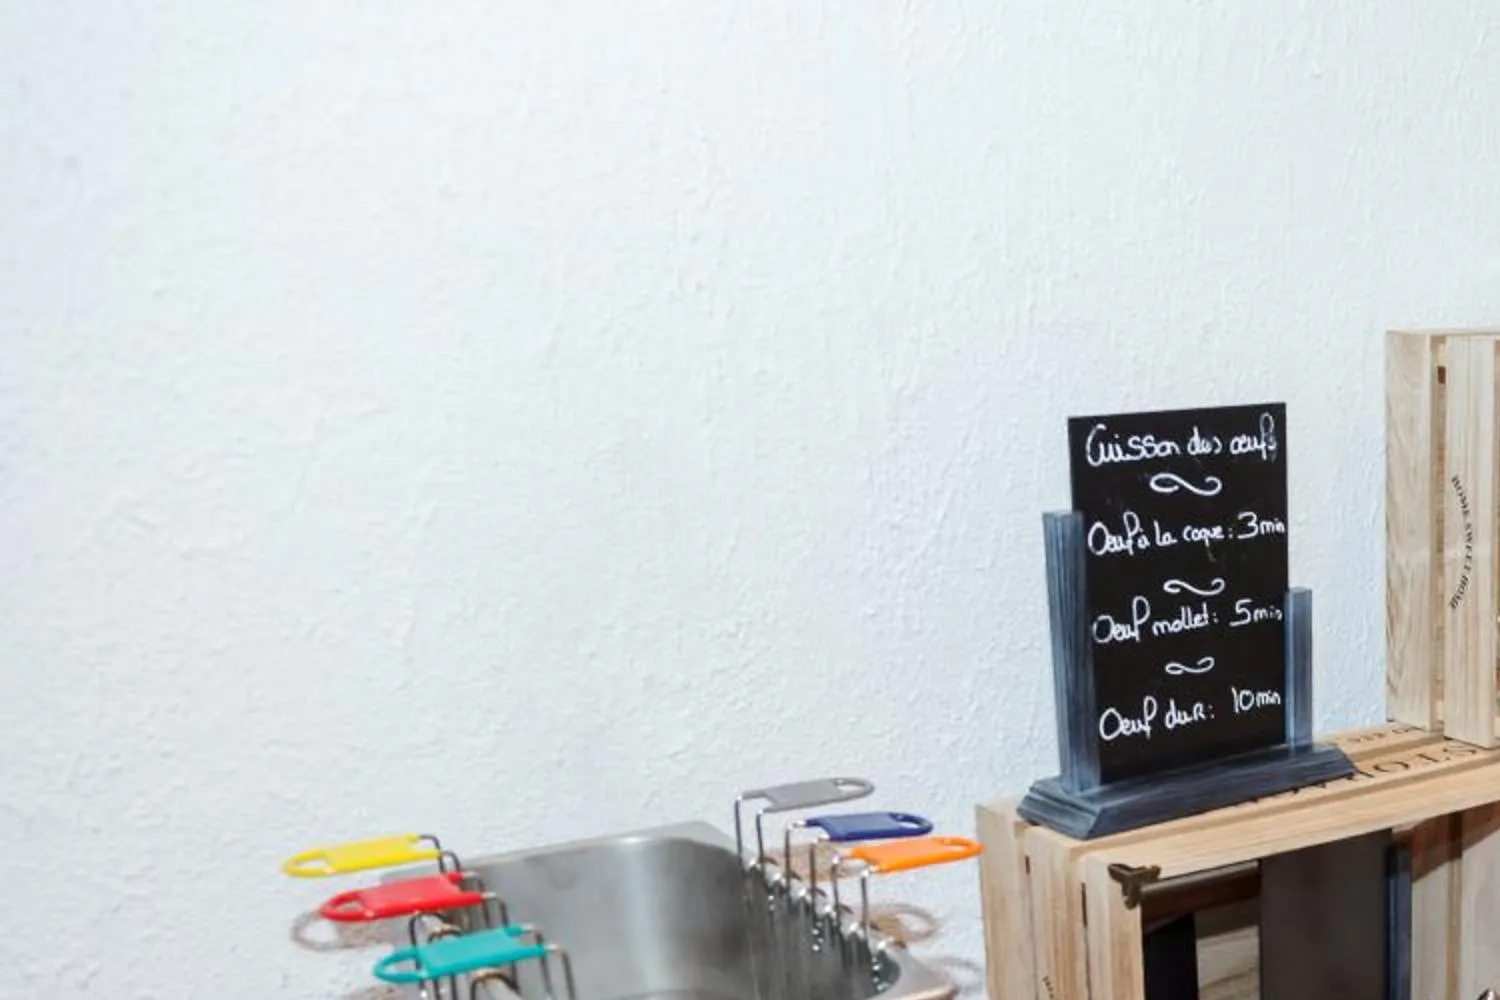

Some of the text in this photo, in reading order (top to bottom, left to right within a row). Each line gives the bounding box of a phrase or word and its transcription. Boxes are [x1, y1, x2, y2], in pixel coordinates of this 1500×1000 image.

[1085, 422, 1181, 467] Cuisson
[1153, 520, 1179, 547] la
[1099, 695, 1158, 741] Oeuf
